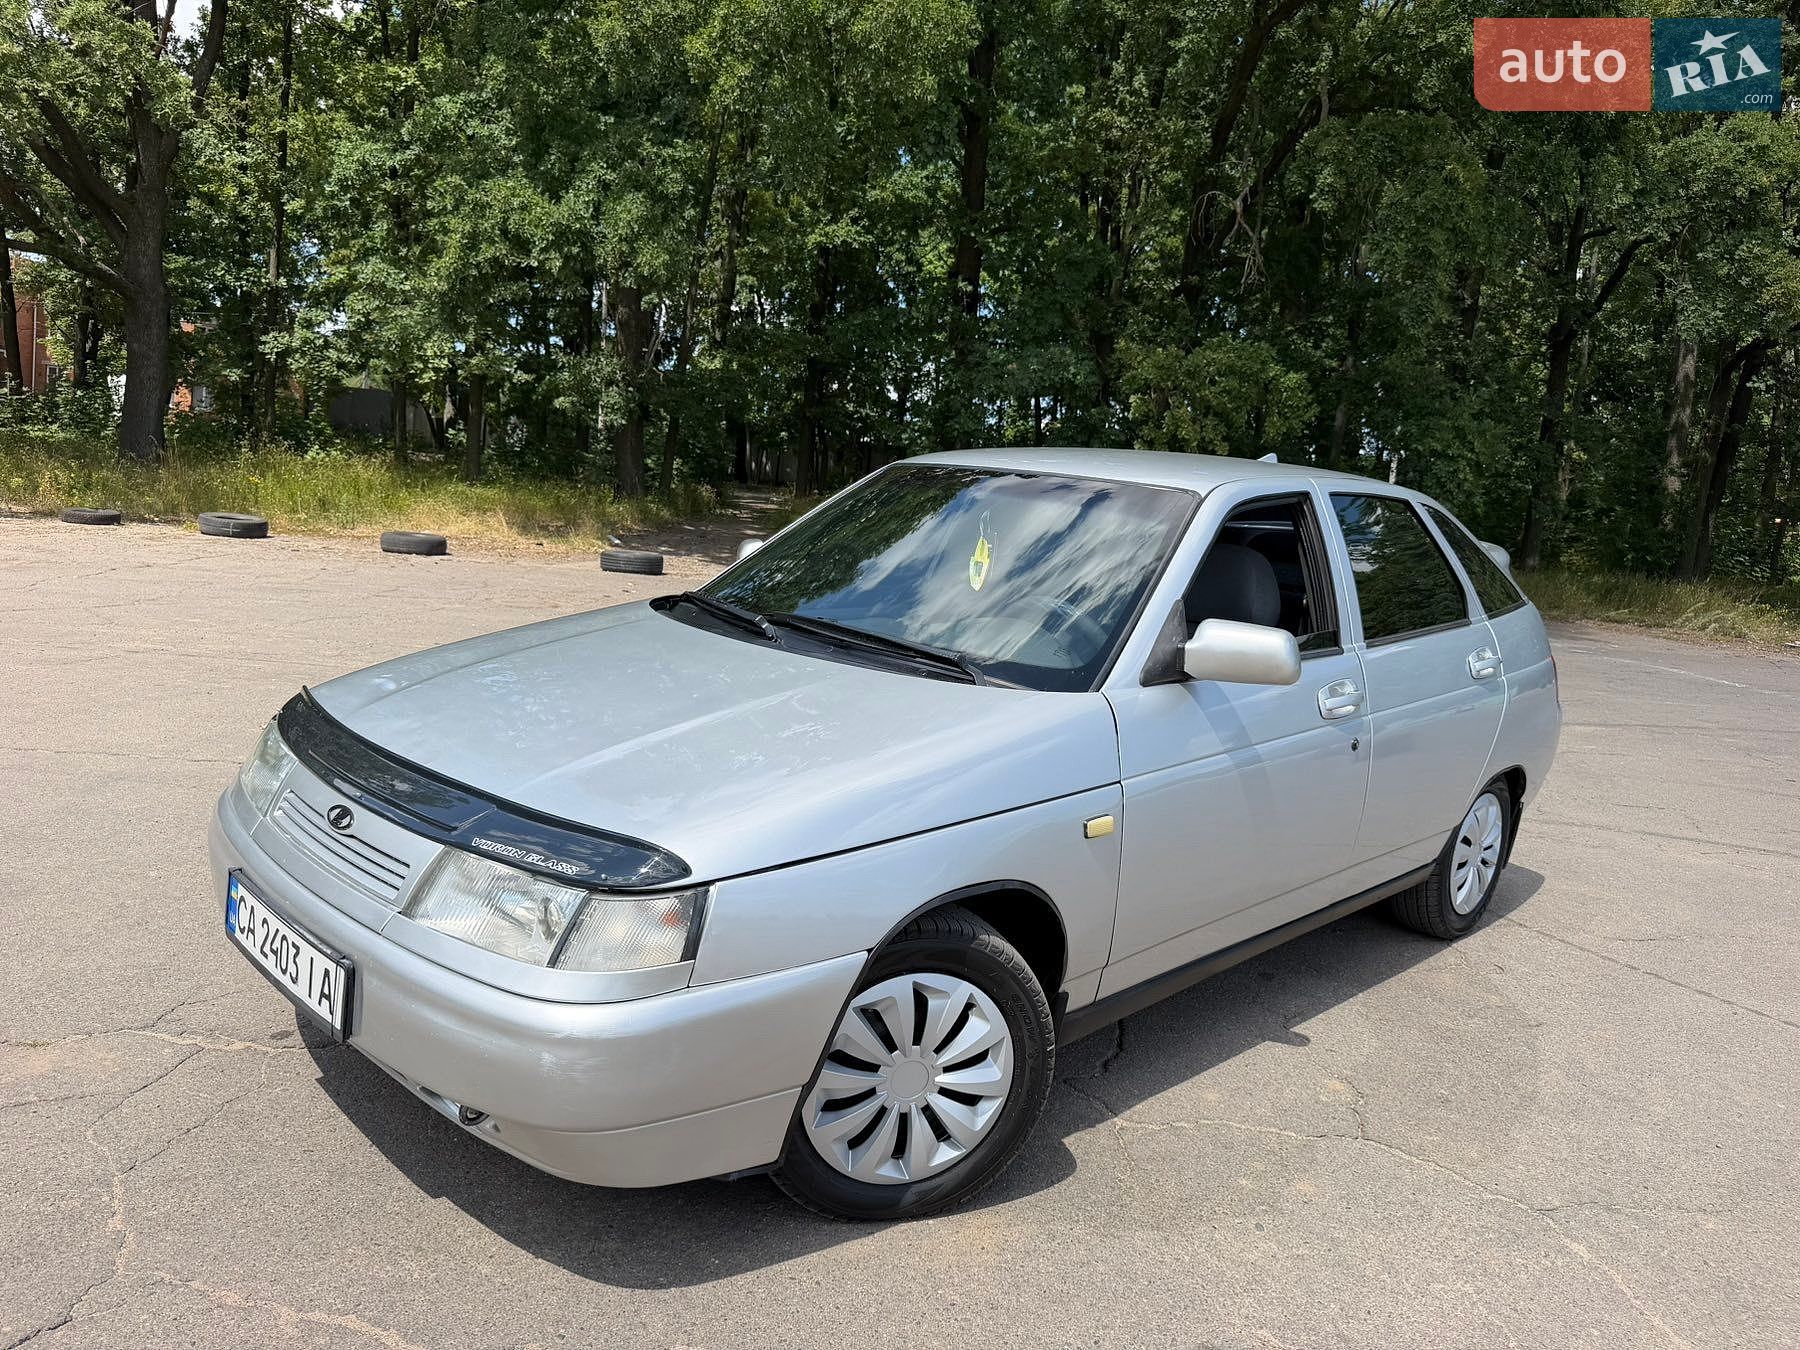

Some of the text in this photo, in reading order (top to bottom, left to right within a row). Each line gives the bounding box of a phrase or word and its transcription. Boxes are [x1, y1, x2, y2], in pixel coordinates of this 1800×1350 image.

[524, 852, 580, 876] GLASS
[237, 895, 334, 1016] CA 2403 IA
